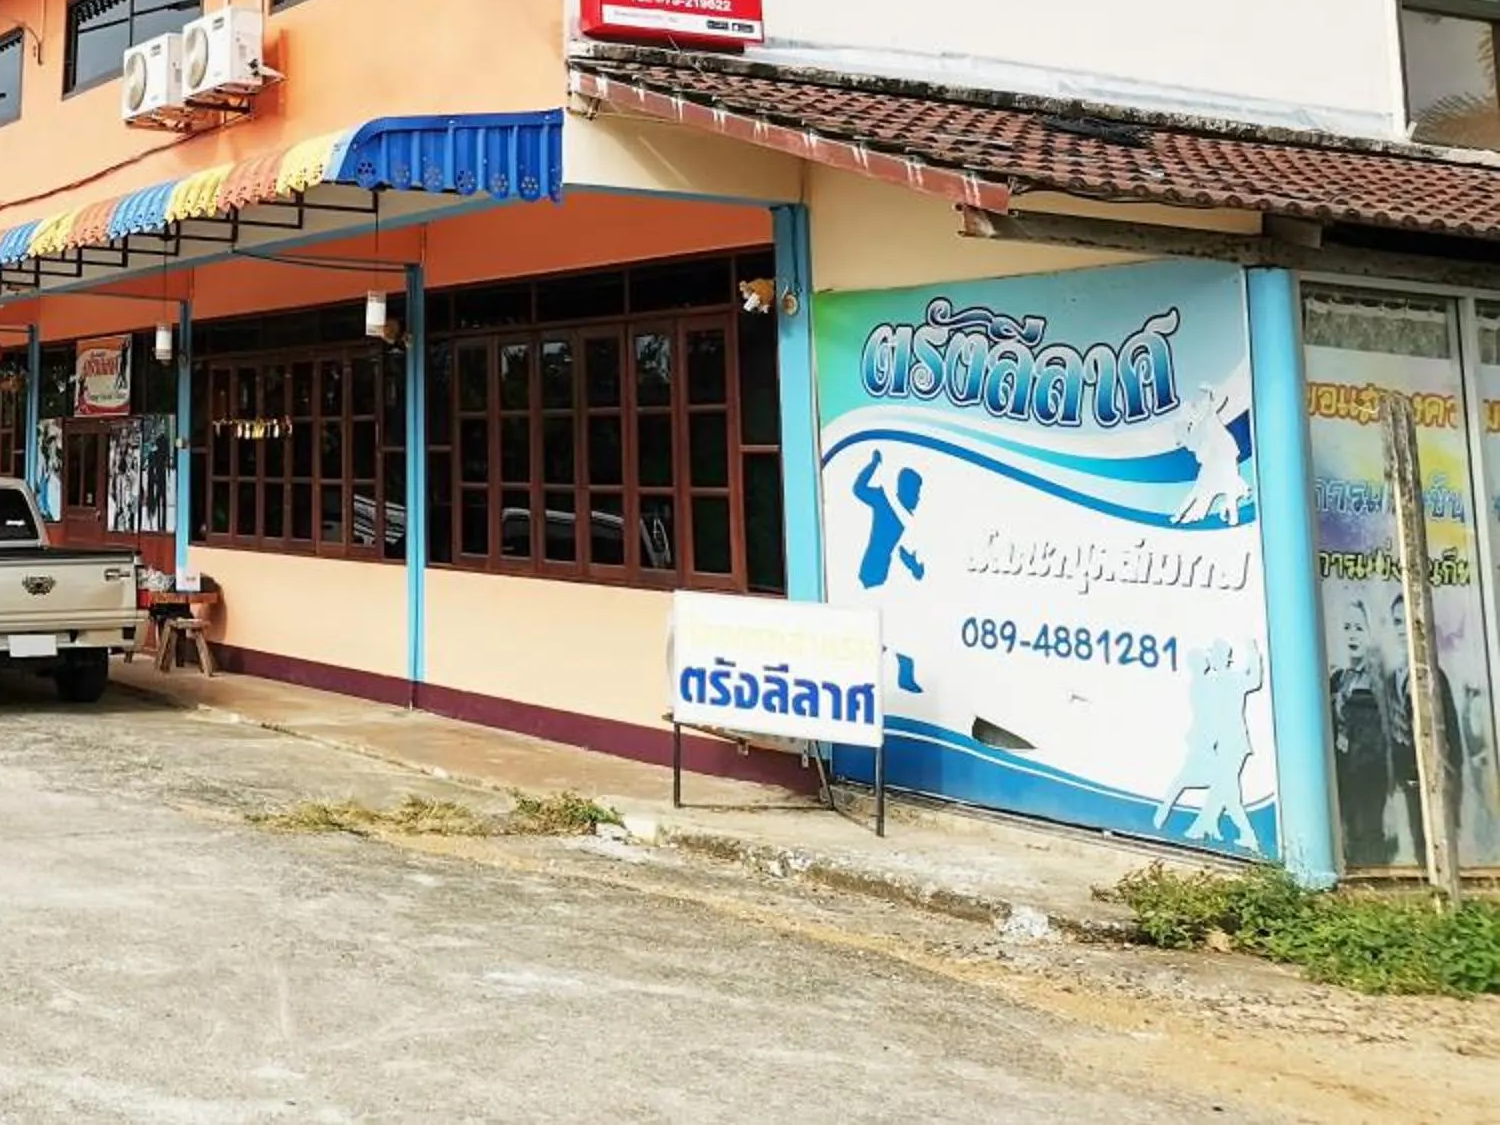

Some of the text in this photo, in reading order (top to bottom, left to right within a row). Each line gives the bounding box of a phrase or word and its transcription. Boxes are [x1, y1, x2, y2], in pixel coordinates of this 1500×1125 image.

[861, 297, 1180, 428] ตรังลีลาศ
[961, 617, 1178, 672] 089-4881281
[679, 657, 876, 725] ตรังลีลาศ
